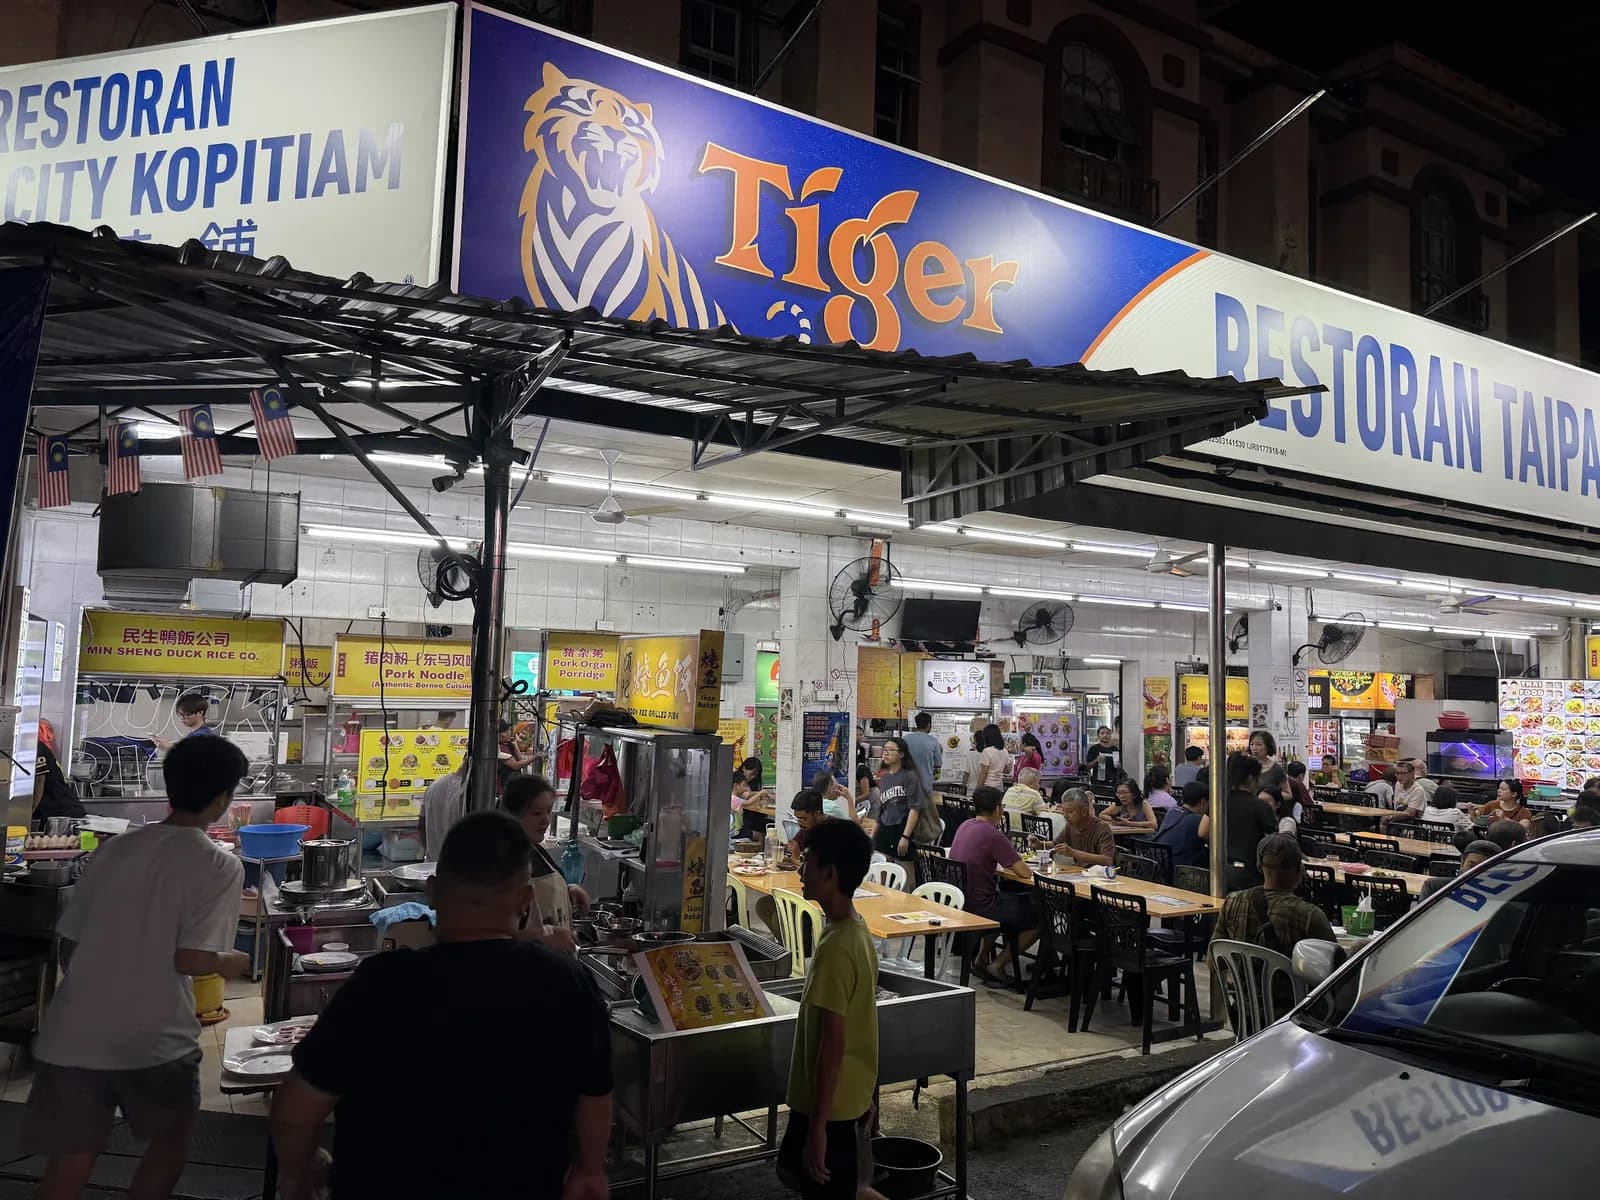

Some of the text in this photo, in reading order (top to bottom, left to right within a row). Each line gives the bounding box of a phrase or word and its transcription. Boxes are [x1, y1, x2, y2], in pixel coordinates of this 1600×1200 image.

[4, 123, 404, 224] CITY KOPITIAM
[698, 141, 1019, 352] Tiger
[1215, 292, 1483, 474] RESTORAN
[123, 628, 230, 647] 民生鴨飯公司
[87, 646, 259, 661] MIN SHENG DUCK RICE CO.
[553, 659, 612, 669] Pork Organ
[385, 669, 465, 680] Pork Noodle
[559, 670, 605, 680] Porridge
[1191, 701, 1208, 712] Hong
